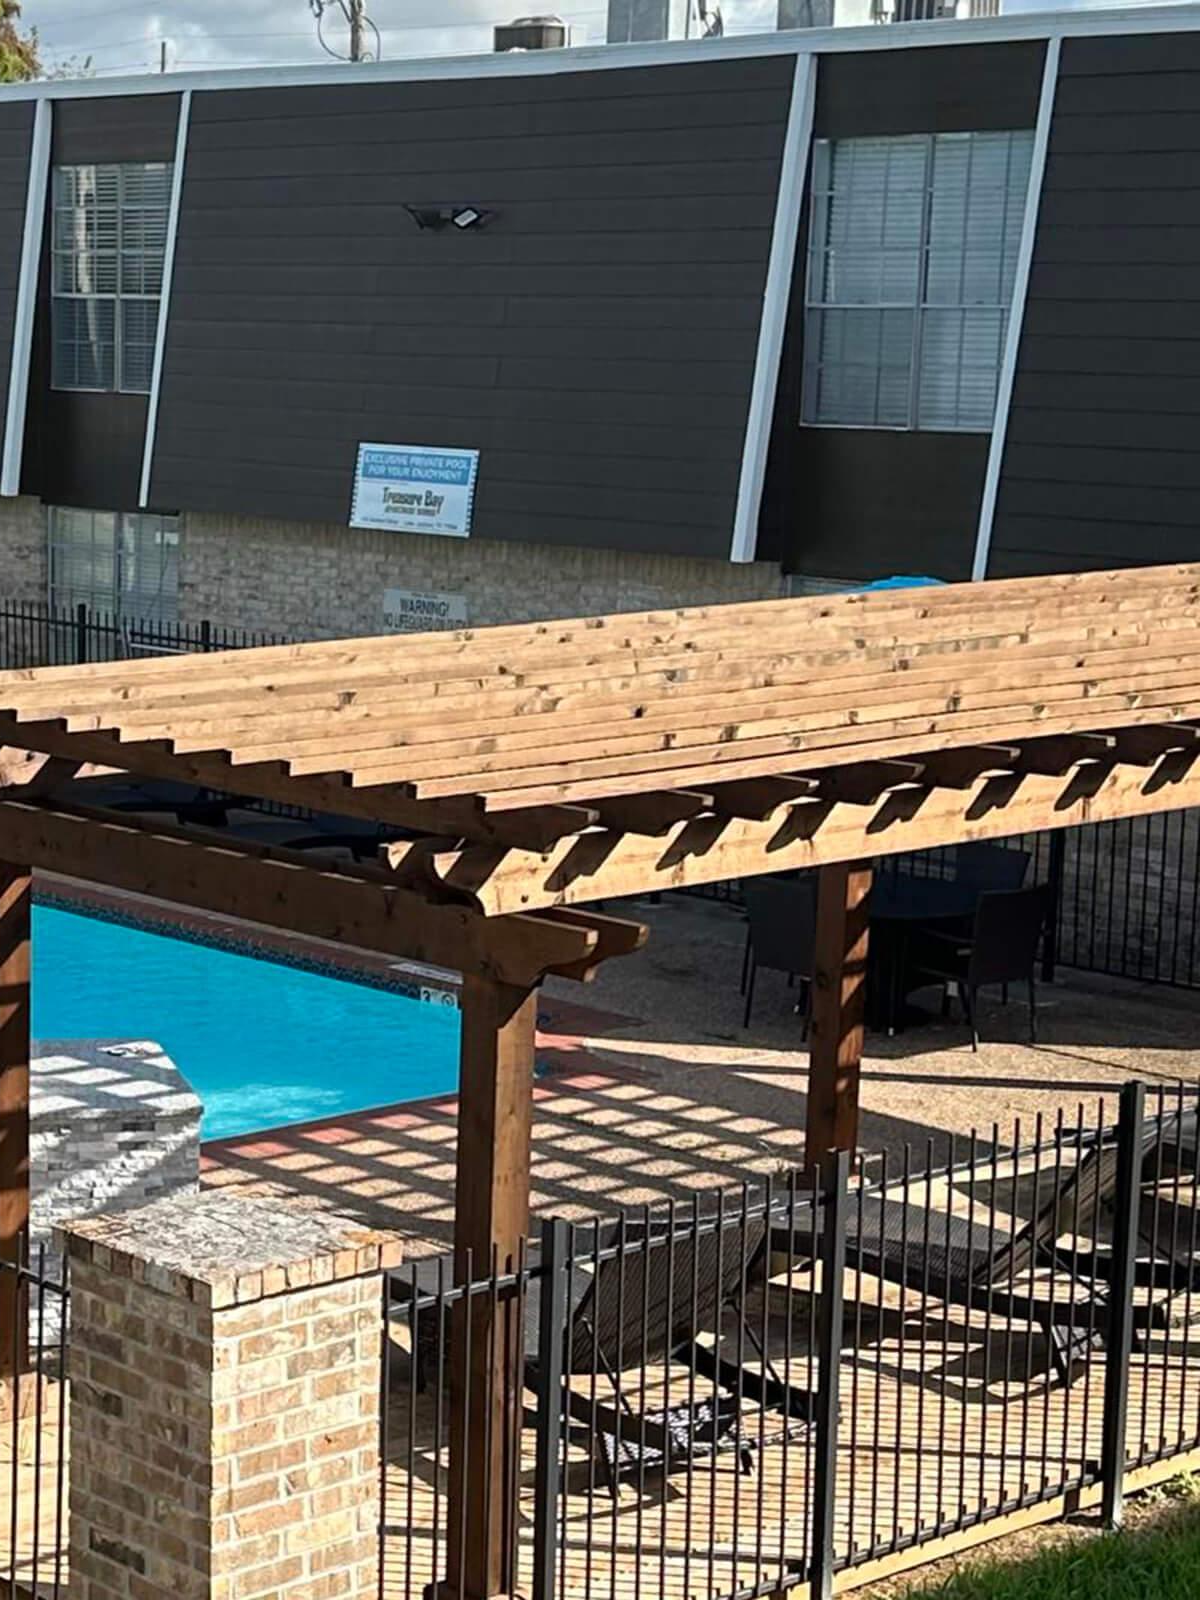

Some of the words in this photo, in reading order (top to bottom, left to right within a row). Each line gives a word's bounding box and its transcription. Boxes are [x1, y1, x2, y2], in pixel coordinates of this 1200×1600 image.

[445, 457, 469, 470] POOL
[383, 487, 423, 506] Treasure
[425, 490, 444, 513] Bay
